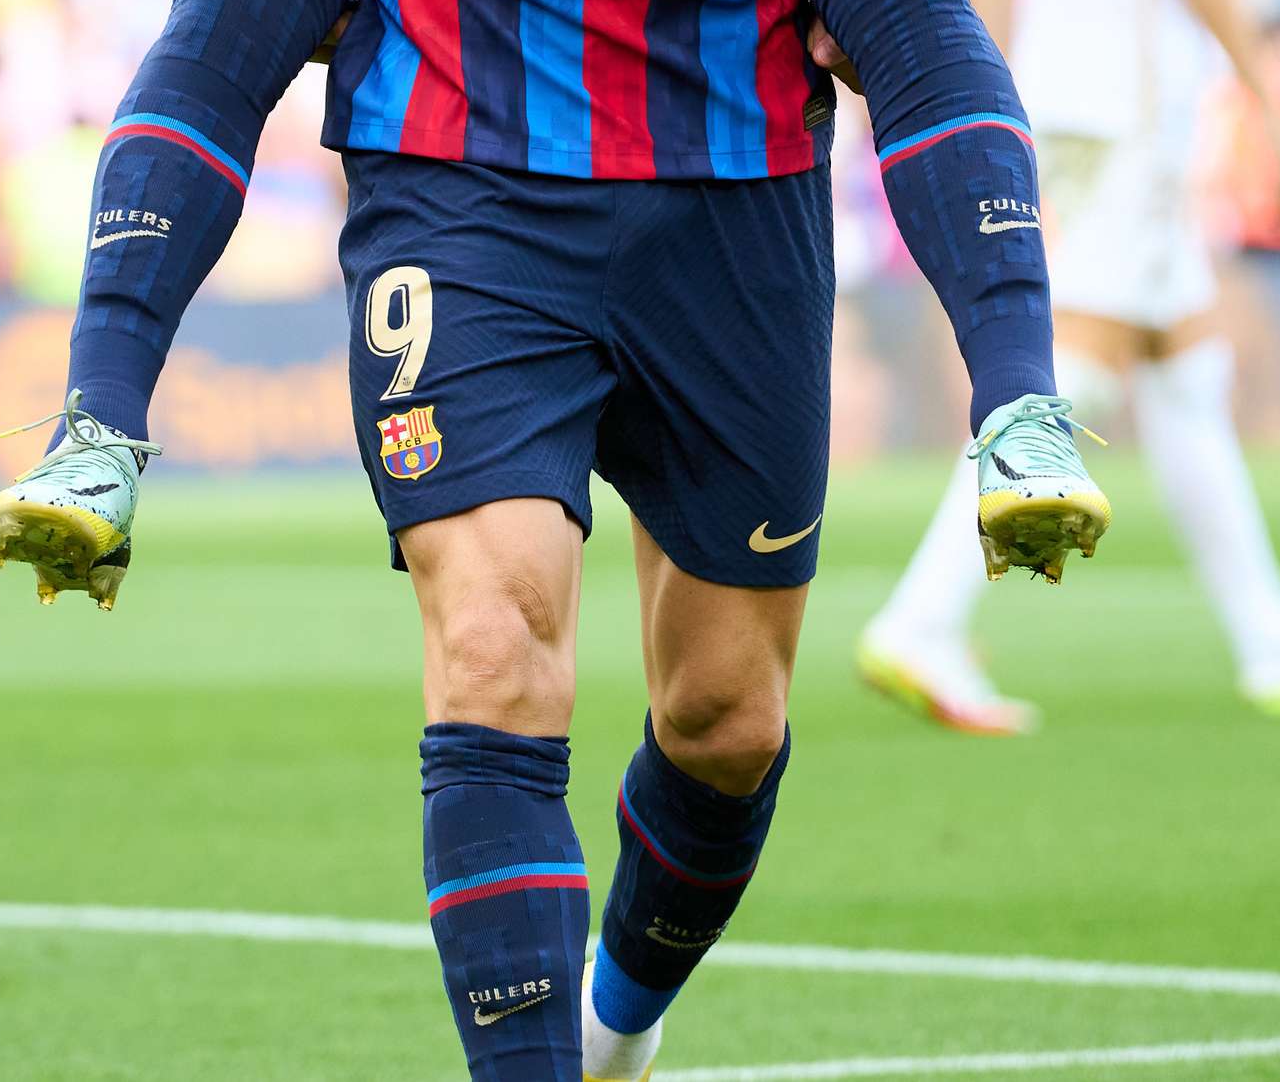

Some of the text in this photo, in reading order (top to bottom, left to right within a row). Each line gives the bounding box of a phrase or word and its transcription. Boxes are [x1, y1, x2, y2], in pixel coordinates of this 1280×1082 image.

[95, 208, 173, 232] CULERS
[978, 198, 1041, 224] CULER
[365, 265, 433, 402] 9
[467, 977, 552, 1004] CULERS
